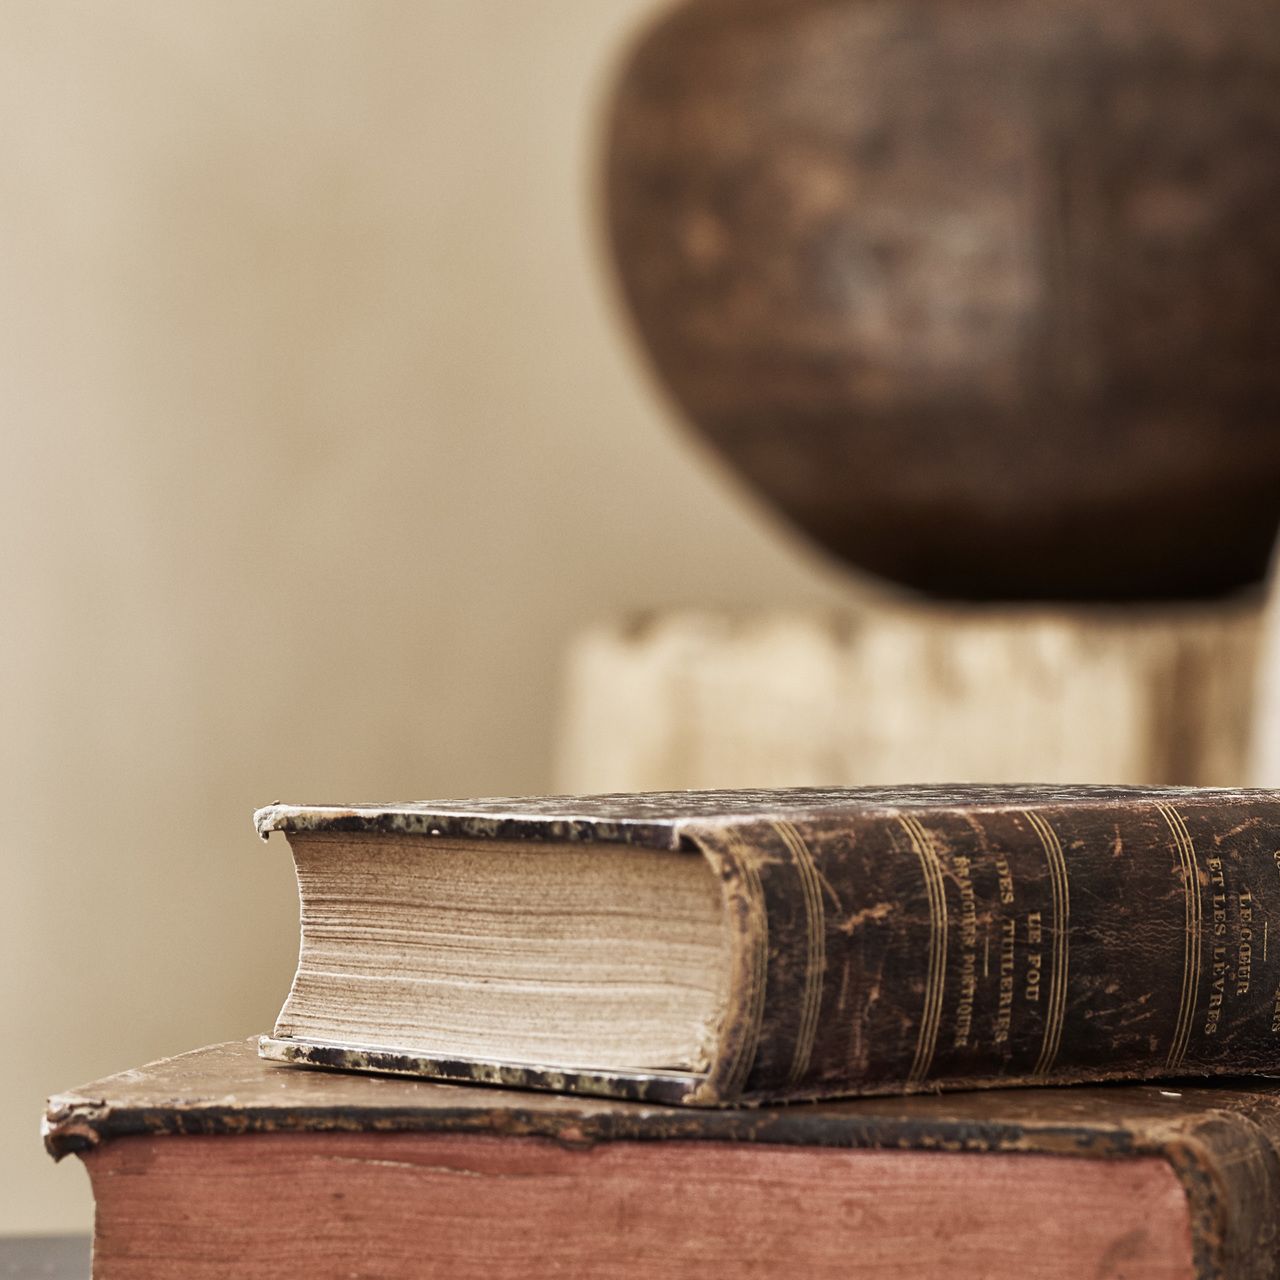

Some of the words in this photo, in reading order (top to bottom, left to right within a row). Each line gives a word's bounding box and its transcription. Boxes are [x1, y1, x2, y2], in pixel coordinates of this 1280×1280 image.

[996, 860, 1014, 904] DES
[1206, 857, 1224, 887] ET
[1027, 912, 1041, 943] LE
[1213, 895, 1226, 936] LES
[1239, 892, 1251, 922] LE
[994, 920, 1015, 1044] TUILERIES
[1025, 954, 1041, 1001] FOU
[1204, 948, 1229, 1036] LÈVRES
